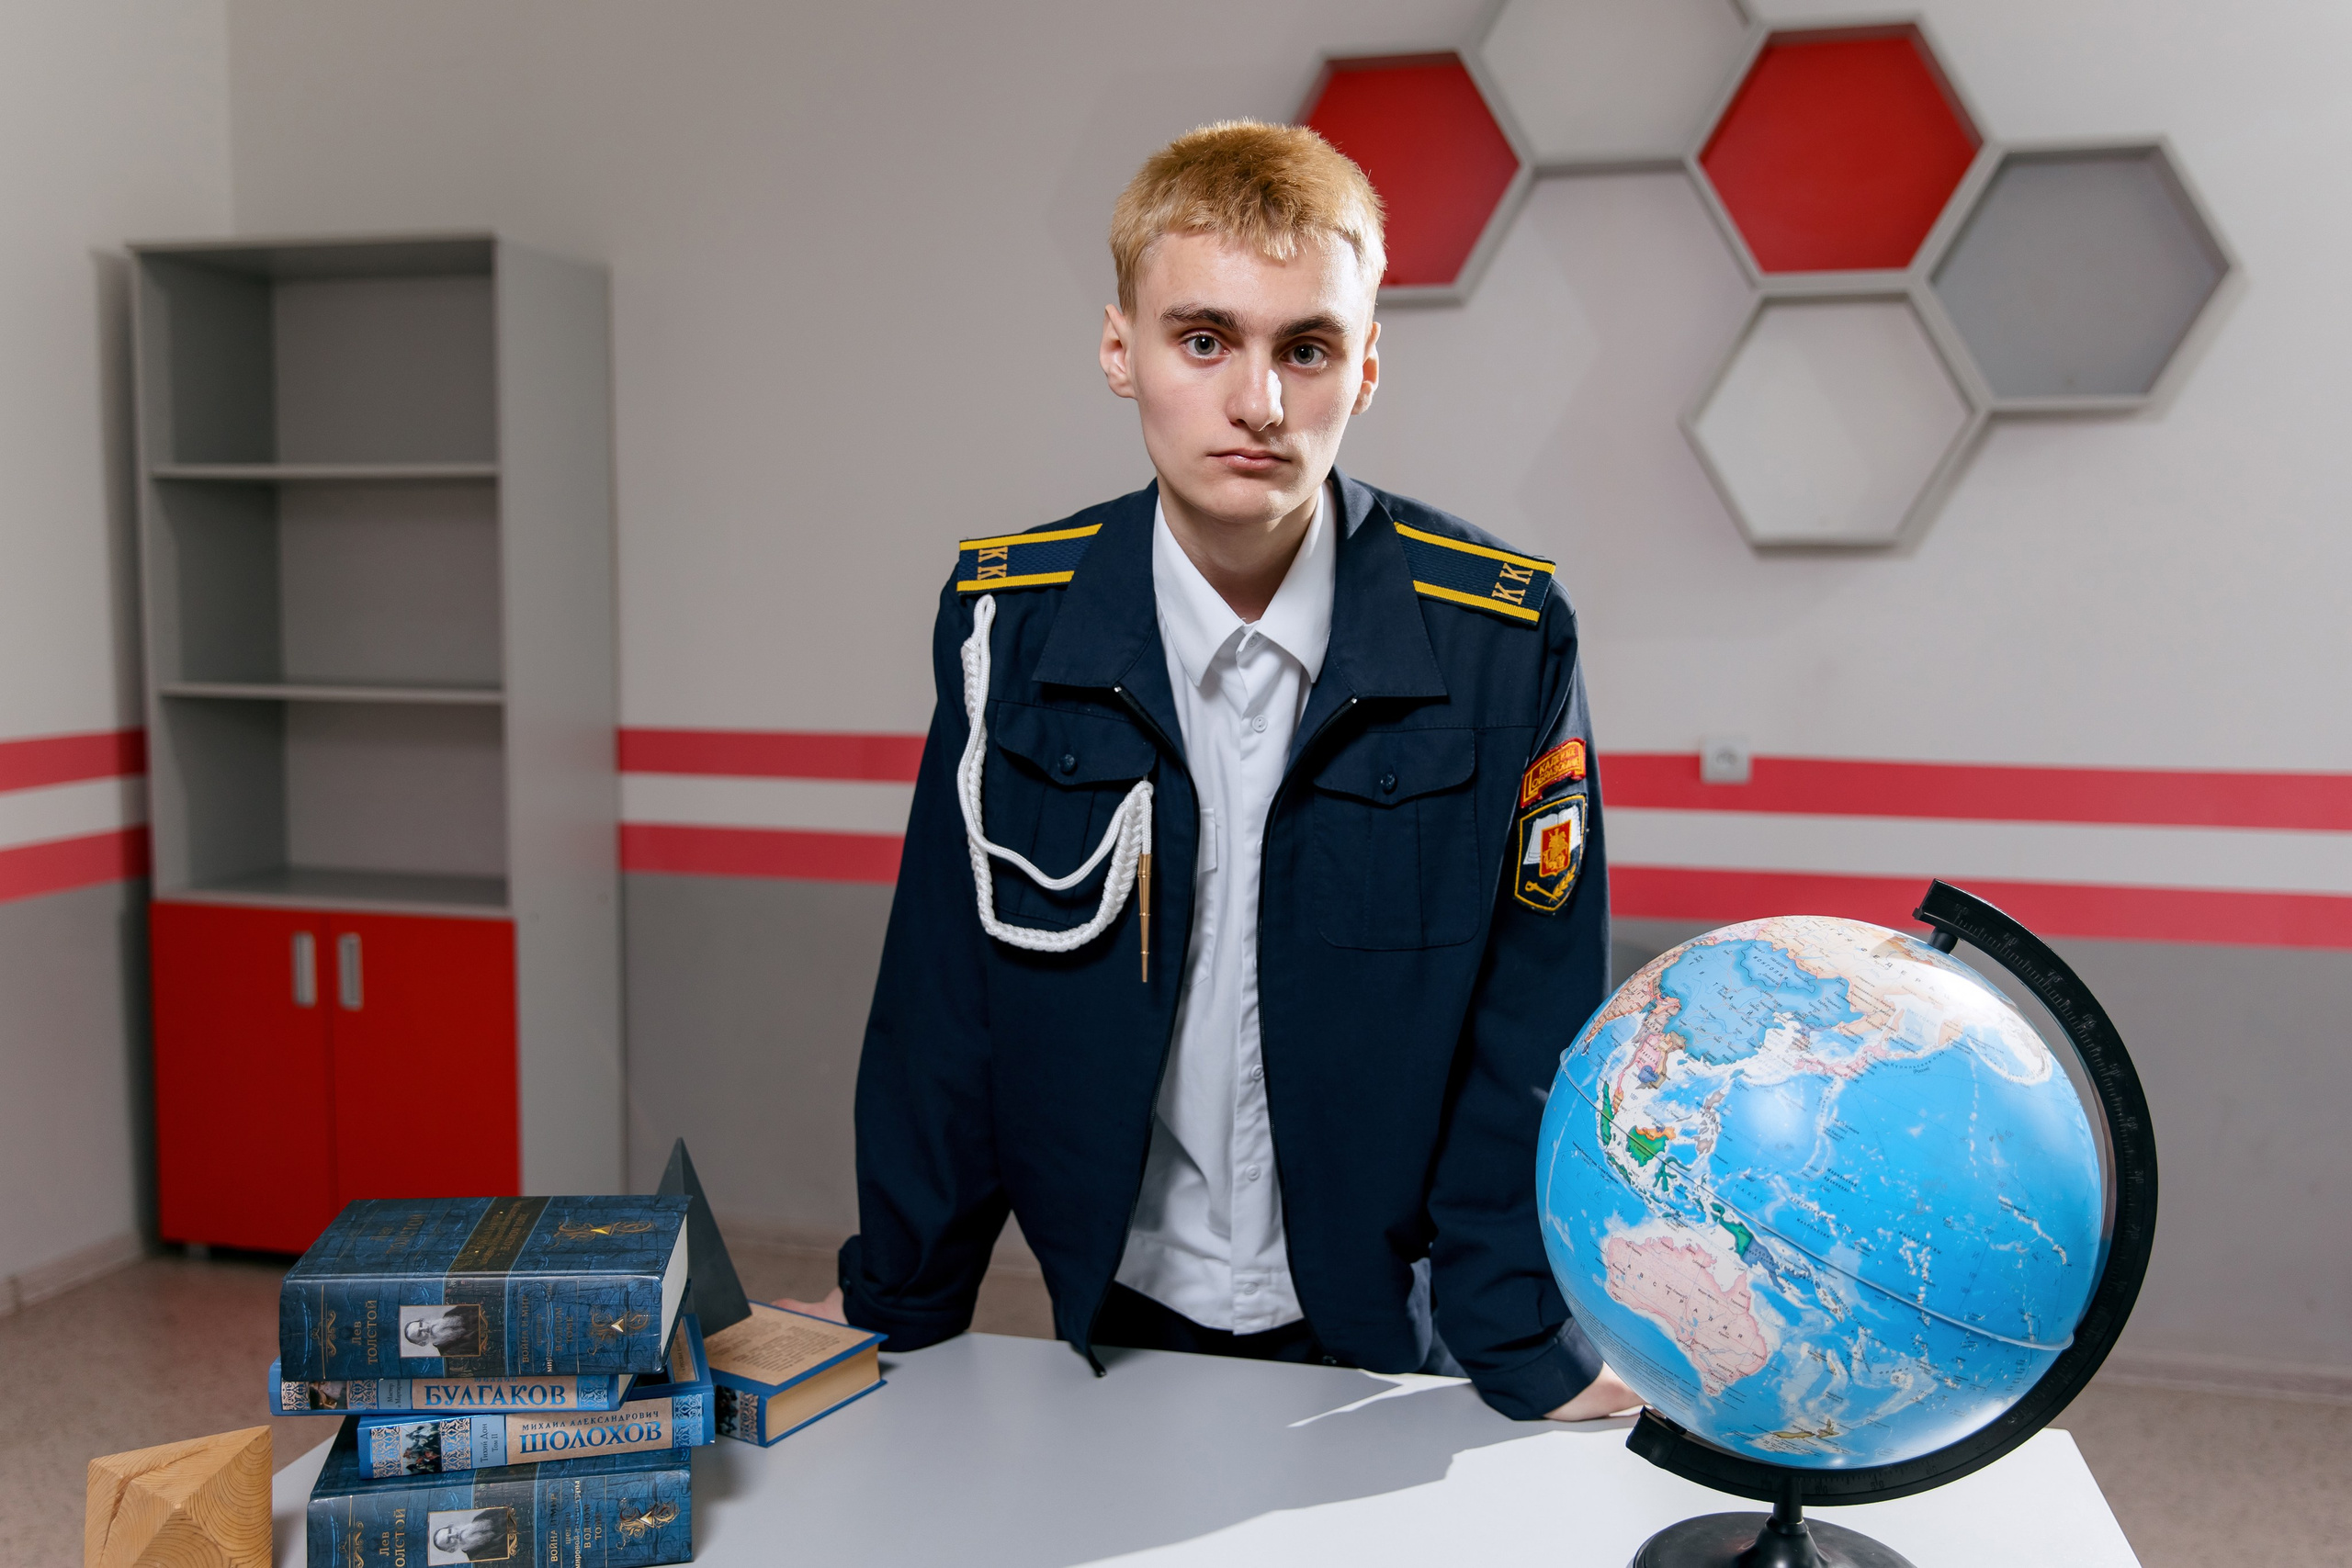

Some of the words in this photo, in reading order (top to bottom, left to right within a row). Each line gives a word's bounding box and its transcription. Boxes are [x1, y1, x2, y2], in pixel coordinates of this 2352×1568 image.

[1627, 1264, 1744, 1340] АВСТРАЛИЯ
[351, 1321, 362, 1346] Лев
[365, 1300, 379, 1365] ТОЛСТОЙ
[521, 1330, 530, 1363] ВОЙНА
[424, 1384, 567, 1406] БУЛГАКОВ
[480, 1423, 489, 1440] Дон
[522, 1421, 566, 1431] МИХАИЛ
[570, 1410, 660, 1427] АЛЕКСАНДРОВИЧ
[491, 1439, 499, 1453] Том
[519, 1420, 662, 1454] ШОЛОХОВ
[480, 1440, 489, 1463] Тихий
[379, 1531, 390, 1557] Лев
[393, 1508, 406, 1568] ОЛСТОЙ
[548, 1529, 559, 1562] ВОЙНА
